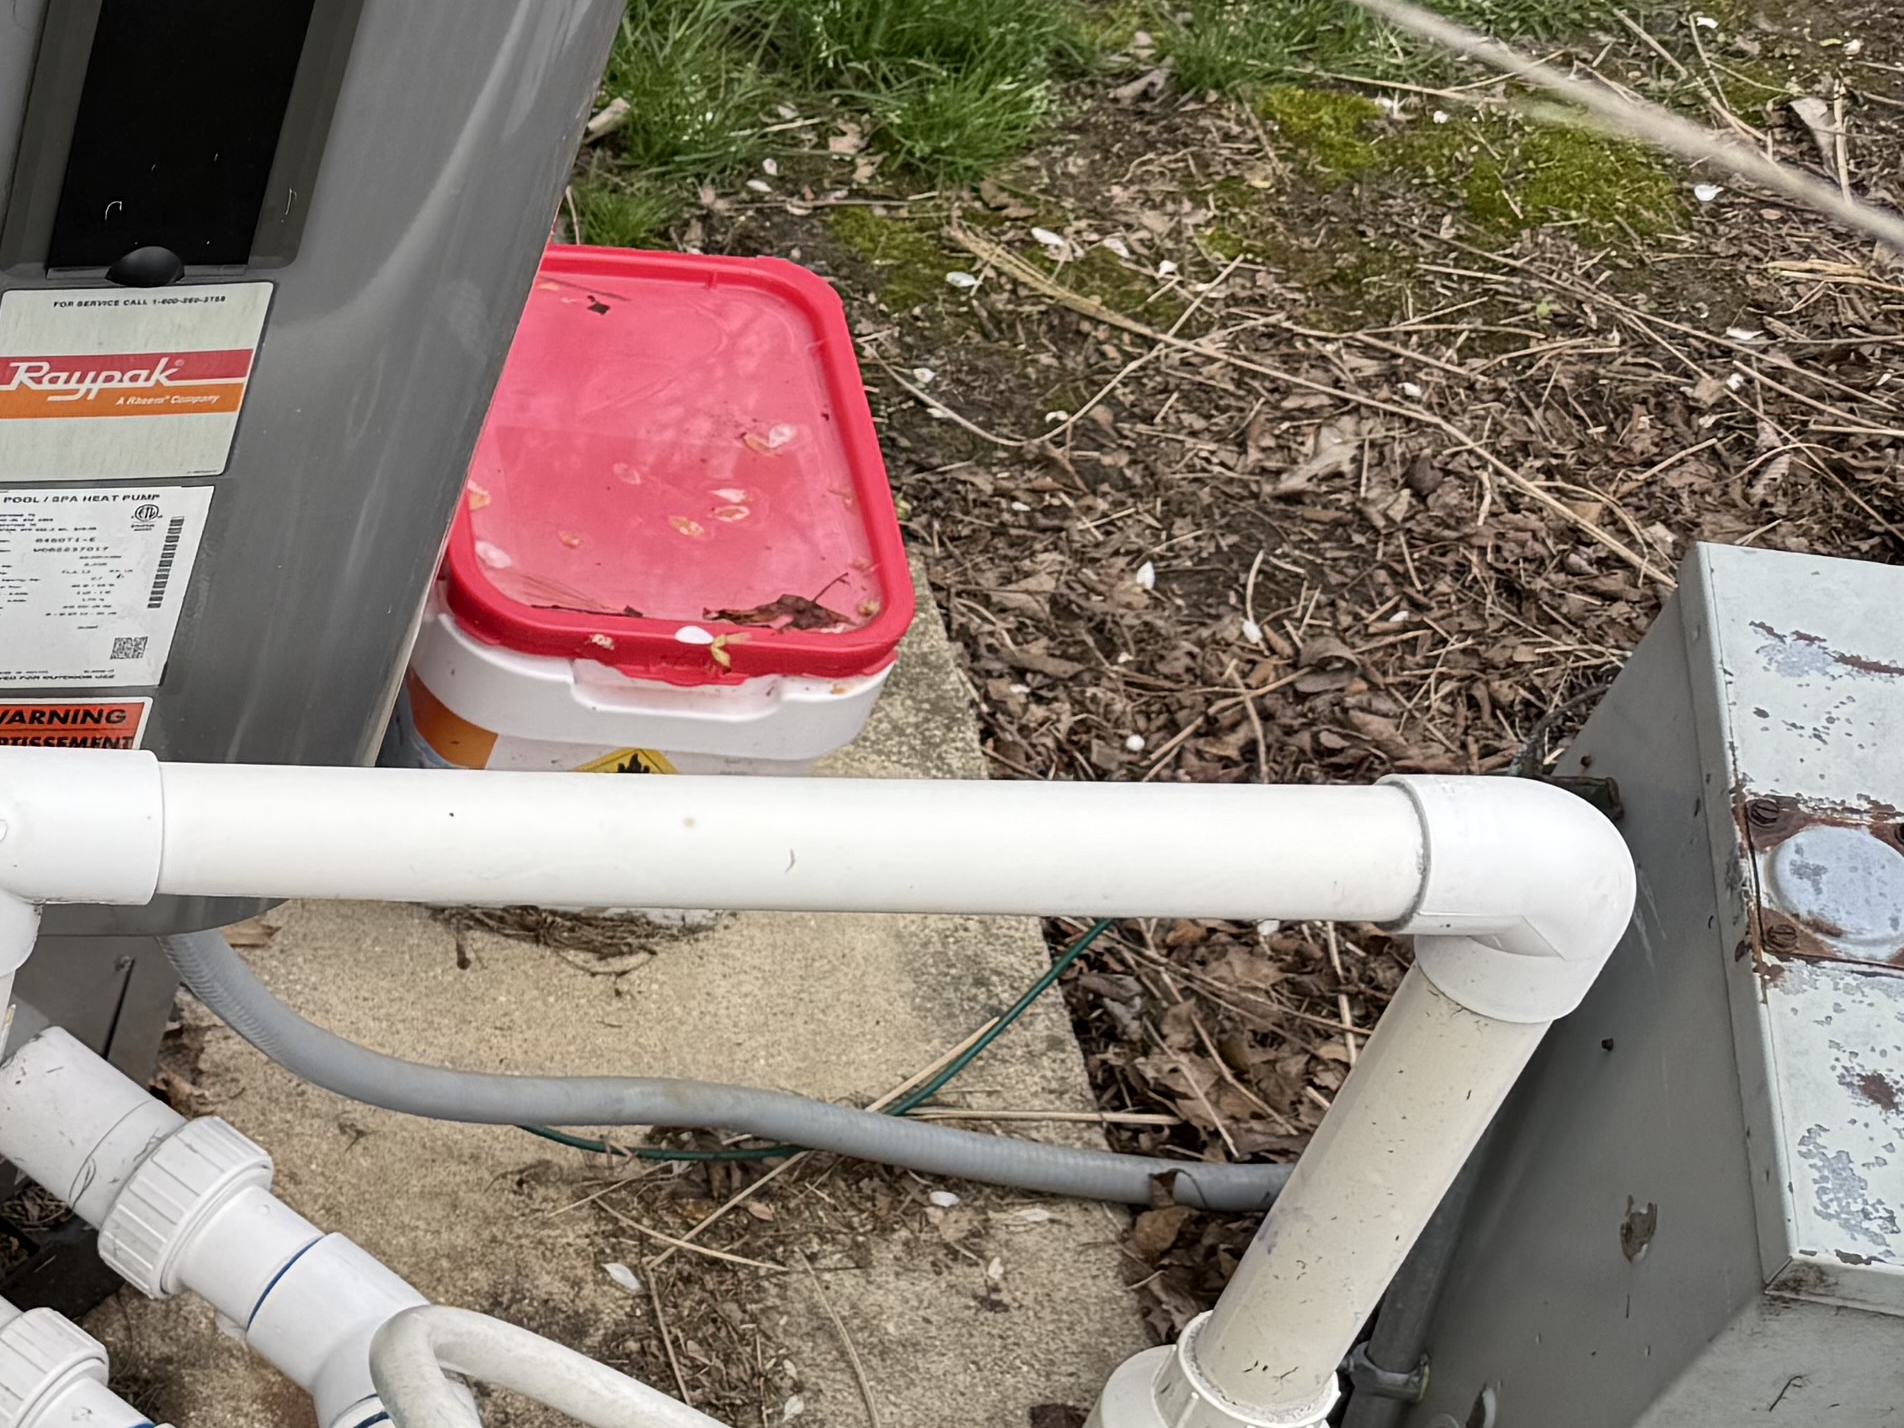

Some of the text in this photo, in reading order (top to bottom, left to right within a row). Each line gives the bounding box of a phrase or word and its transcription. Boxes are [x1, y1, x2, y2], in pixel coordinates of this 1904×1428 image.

[77, 299, 119, 307] SERVICE
[115, 396, 124, 405] A
[170, 394, 221, 405] Company
[3, 496, 40, 504] POOL
[51, 495, 79, 503] SPA
[82, 494, 119, 502] HEAT
[122, 494, 161, 502] PUMP
